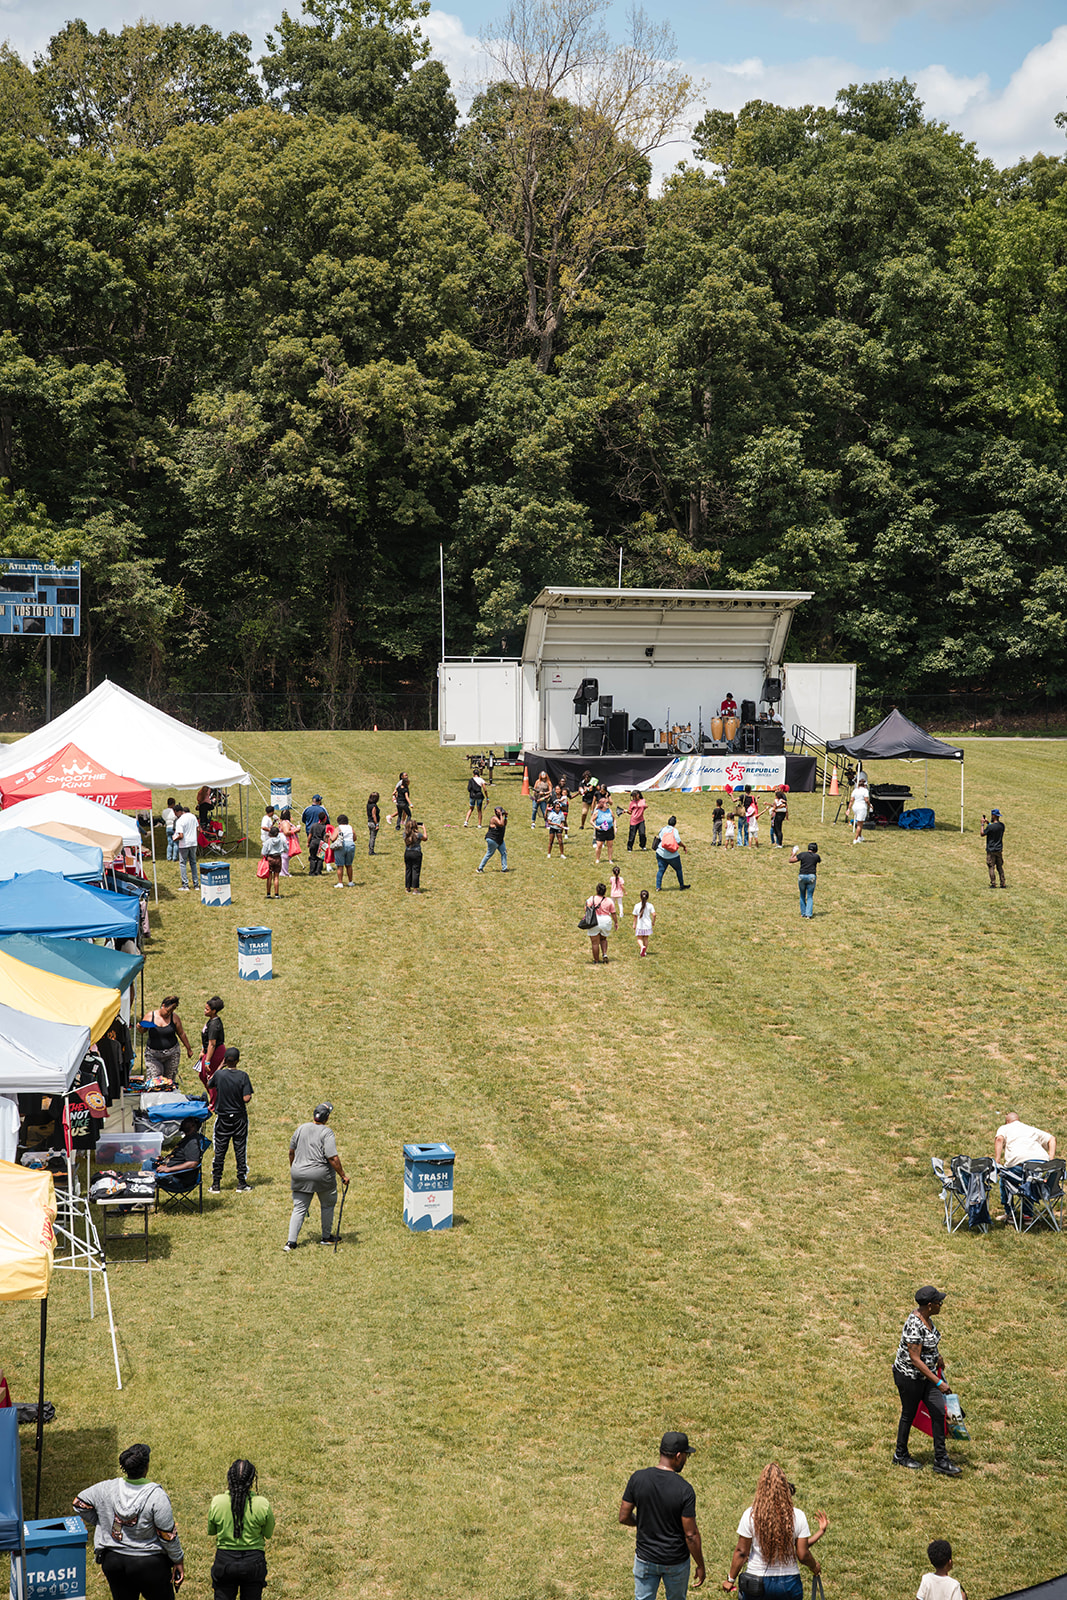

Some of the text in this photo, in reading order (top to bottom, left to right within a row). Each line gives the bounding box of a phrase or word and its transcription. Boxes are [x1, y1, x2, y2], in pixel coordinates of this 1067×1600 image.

[15, 606, 31, 616] YDS
[32, 606, 42, 616] TO
[43, 606, 54, 617] GO
[60, 606, 76, 617] QTR
[45, 773, 107, 784] SMOOTHIE
[70, 1110, 90, 1120] NOT
[71, 1118, 90, 1128] LIKE
[71, 1126, 90, 1136] US
[418, 1172, 448, 1181] TRASH
[27, 1567, 77, 1584] TRASH
